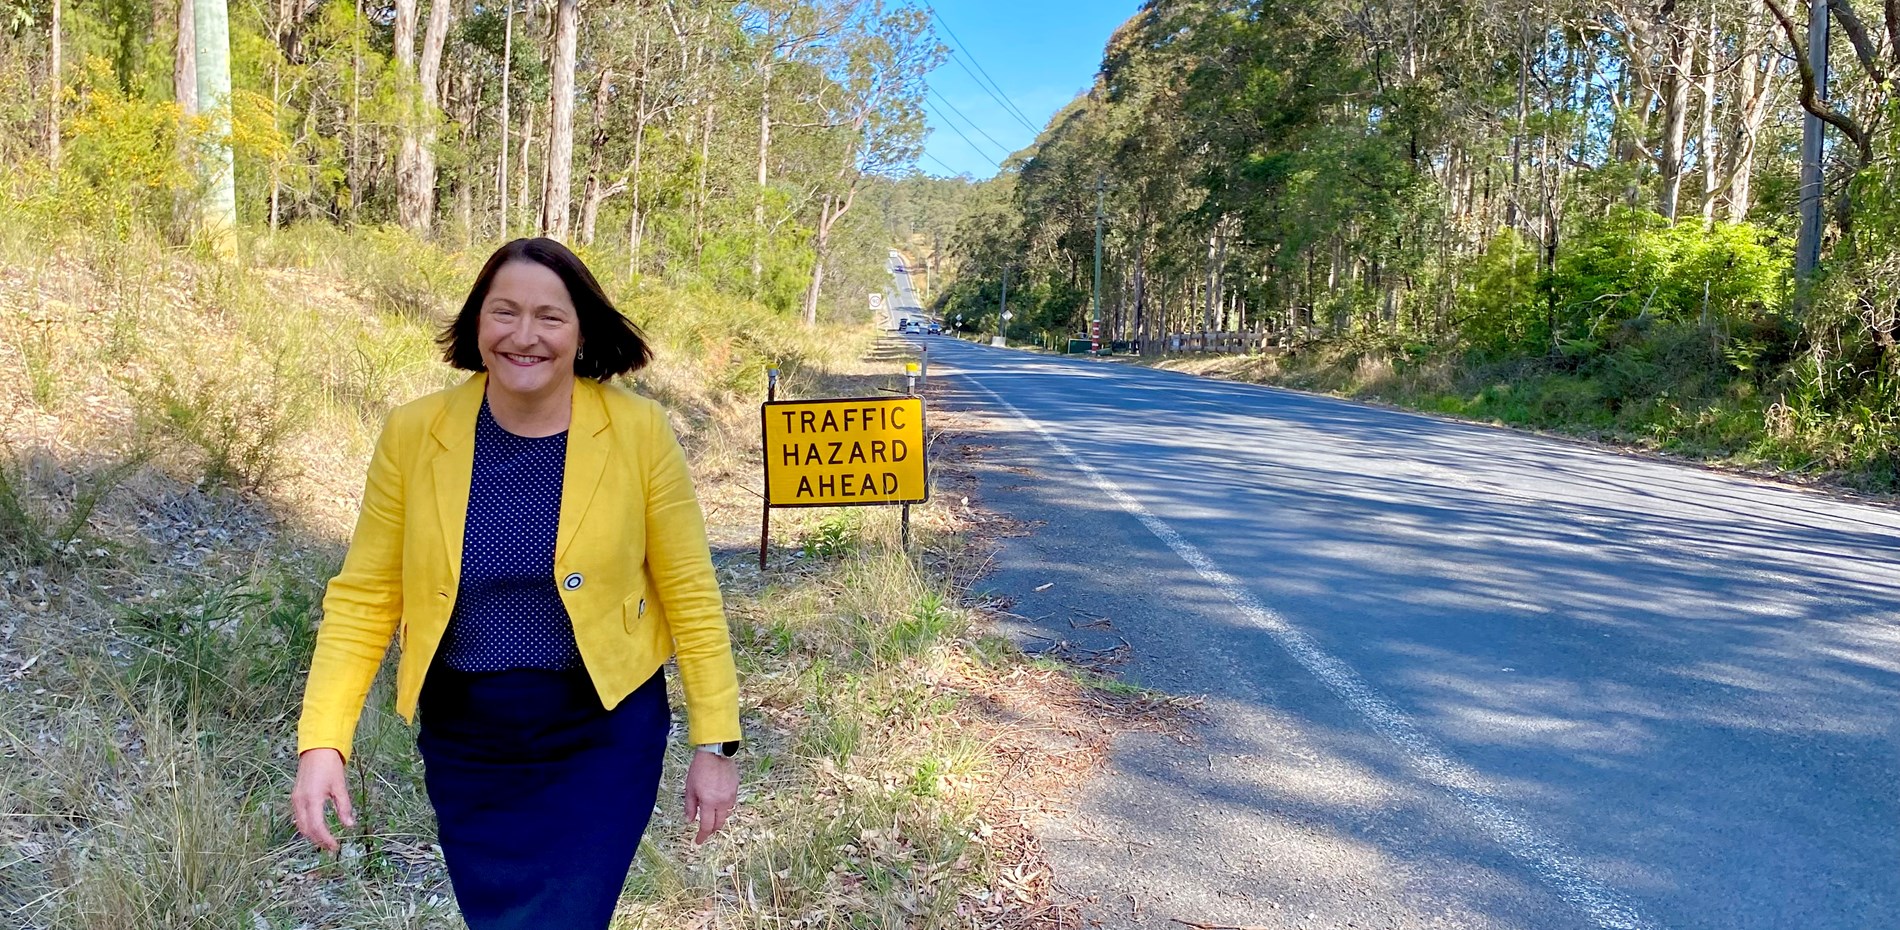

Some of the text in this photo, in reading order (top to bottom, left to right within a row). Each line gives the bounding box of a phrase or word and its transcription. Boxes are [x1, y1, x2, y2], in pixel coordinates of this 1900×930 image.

[782, 407, 906, 433] TRAFFIC
[783, 440, 908, 466] HAZARD
[796, 472, 899, 498] AHEAD
